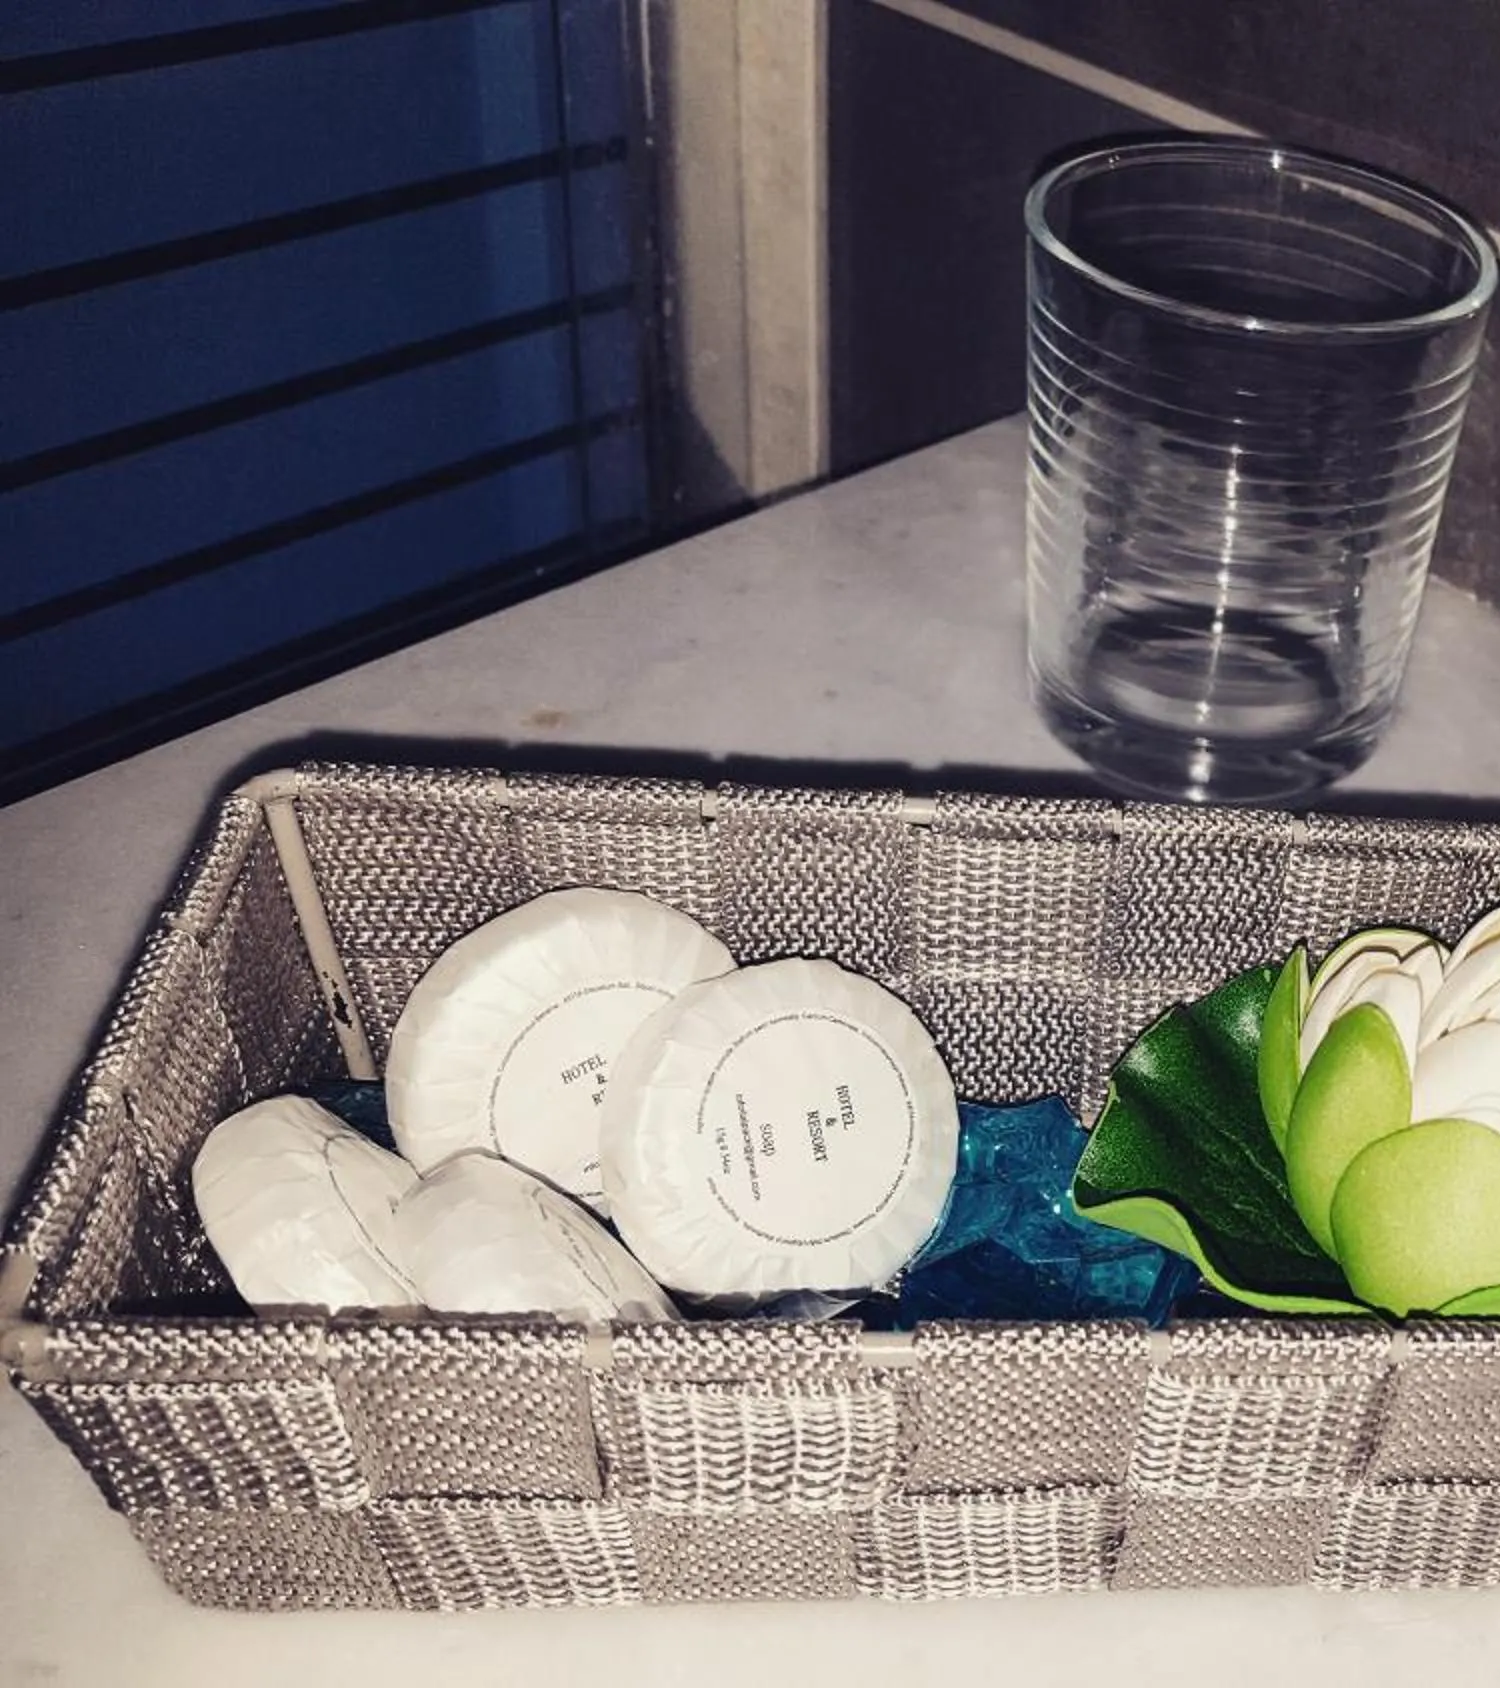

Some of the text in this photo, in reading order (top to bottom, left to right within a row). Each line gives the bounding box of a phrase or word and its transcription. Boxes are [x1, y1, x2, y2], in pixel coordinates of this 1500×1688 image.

[560, 1053, 606, 1084] HOTEL
[835, 1084, 856, 1131] HOTEL
[806, 1109, 829, 1163] RESORT
